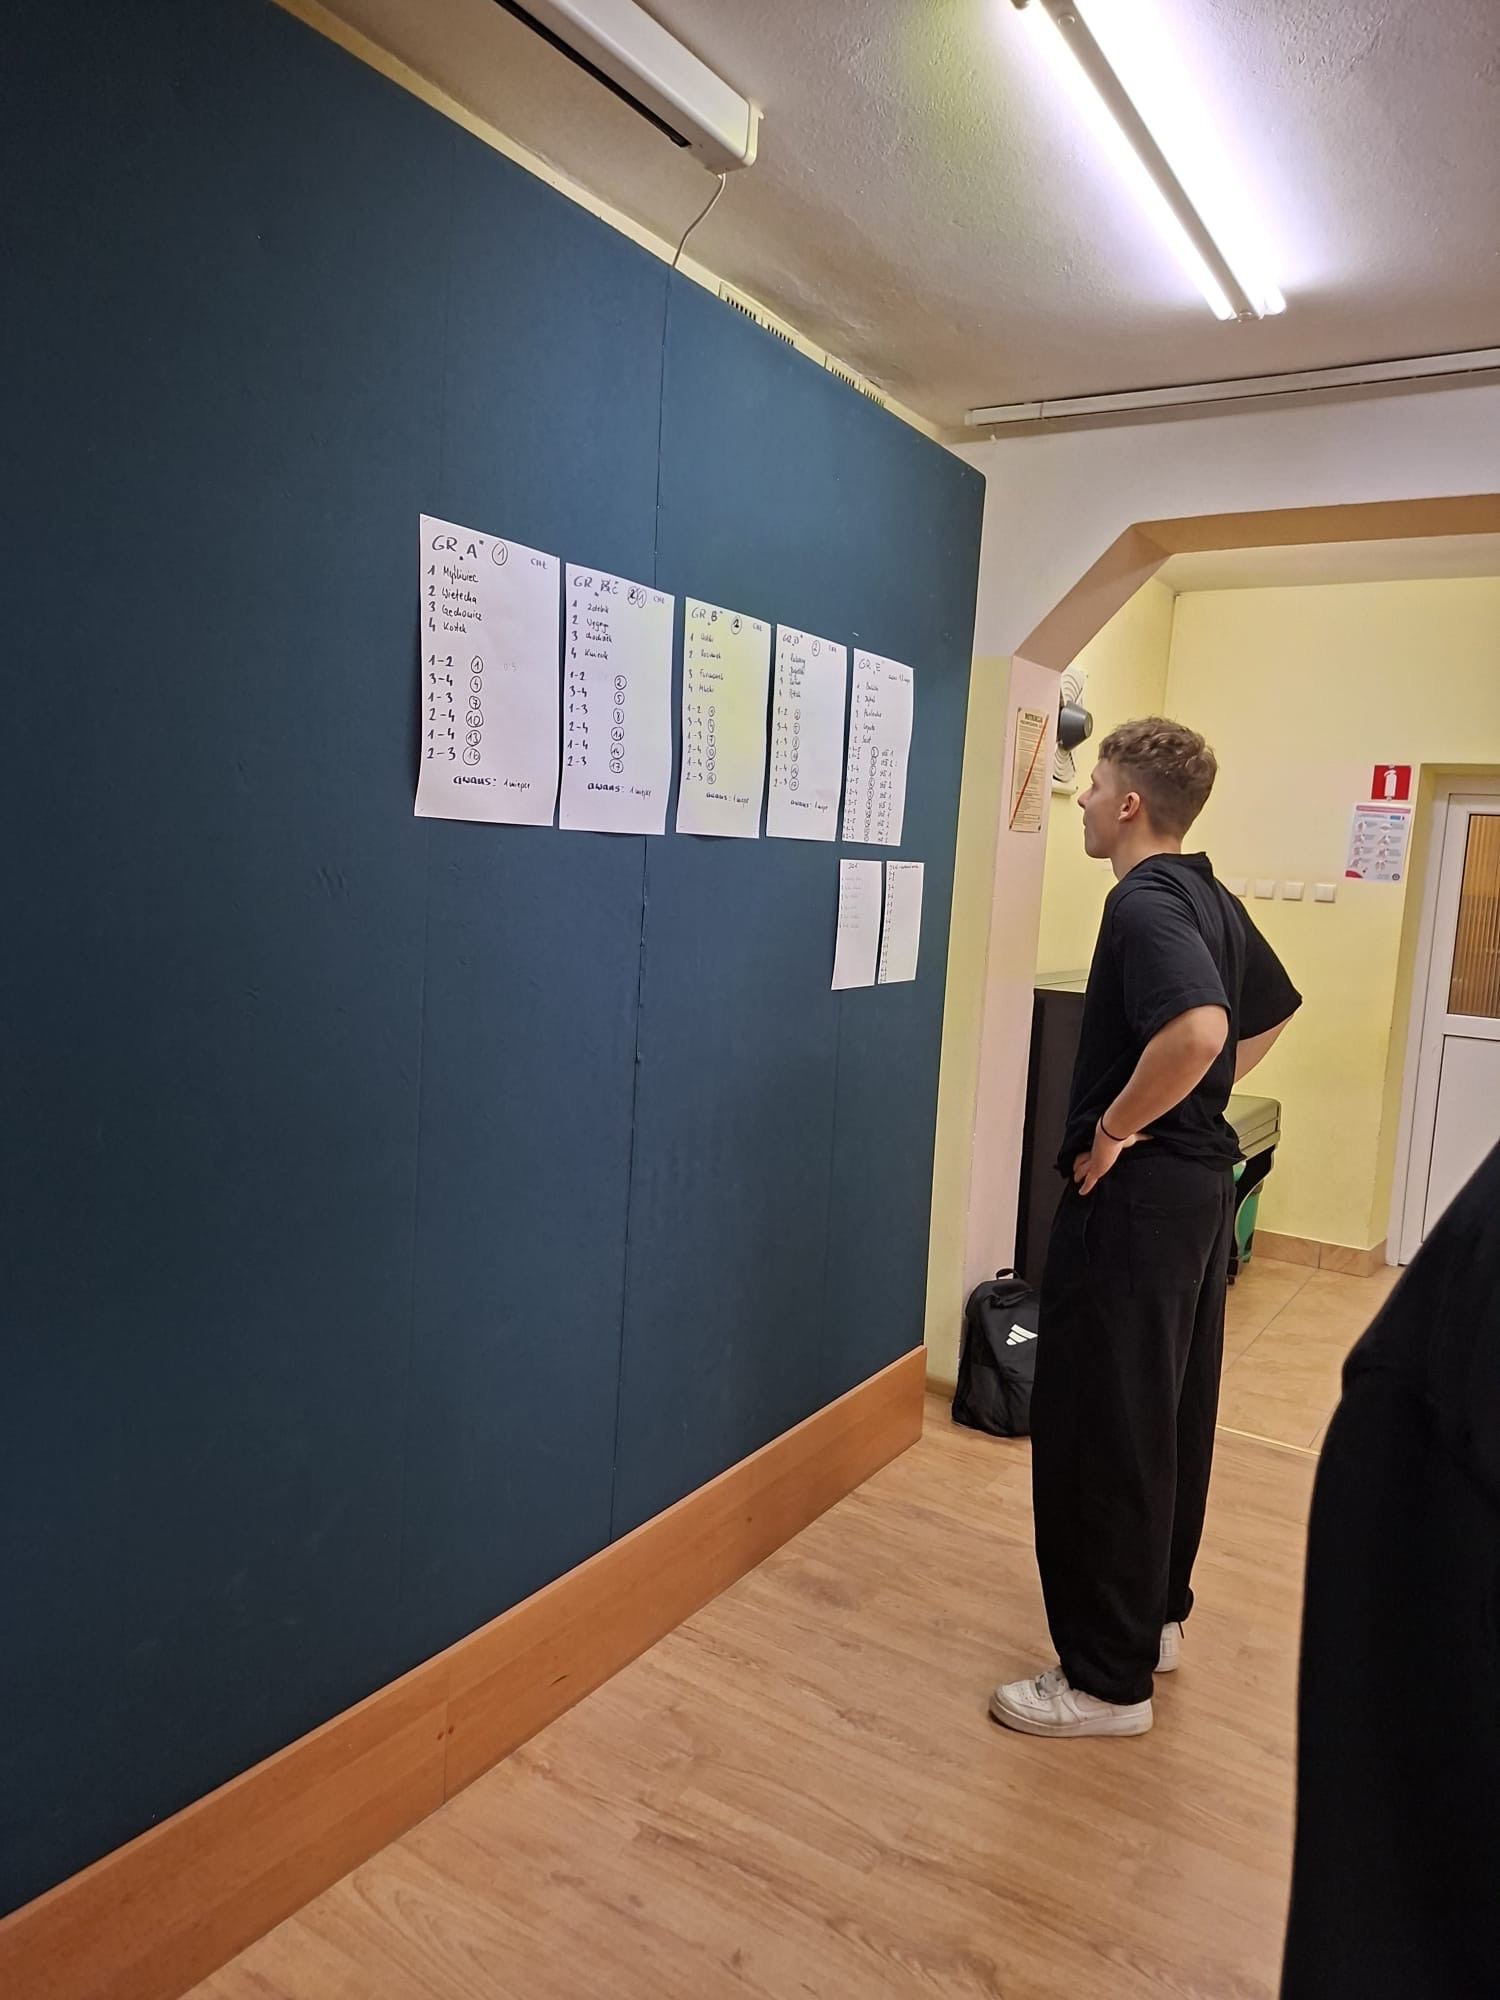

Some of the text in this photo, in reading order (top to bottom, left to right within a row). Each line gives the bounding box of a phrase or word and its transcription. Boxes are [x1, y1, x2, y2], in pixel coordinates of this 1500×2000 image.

[432, 534, 458, 552] GR
[427, 565, 435, 575] 1
[573, 575, 593, 588] GR
[428, 585, 436, 596] 2
[429, 601, 436, 612] 3
[429, 617, 436, 632] 4
[572, 614, 579, 625] 2
[571, 631, 578, 641] 3
[571, 647, 577, 659] 4
